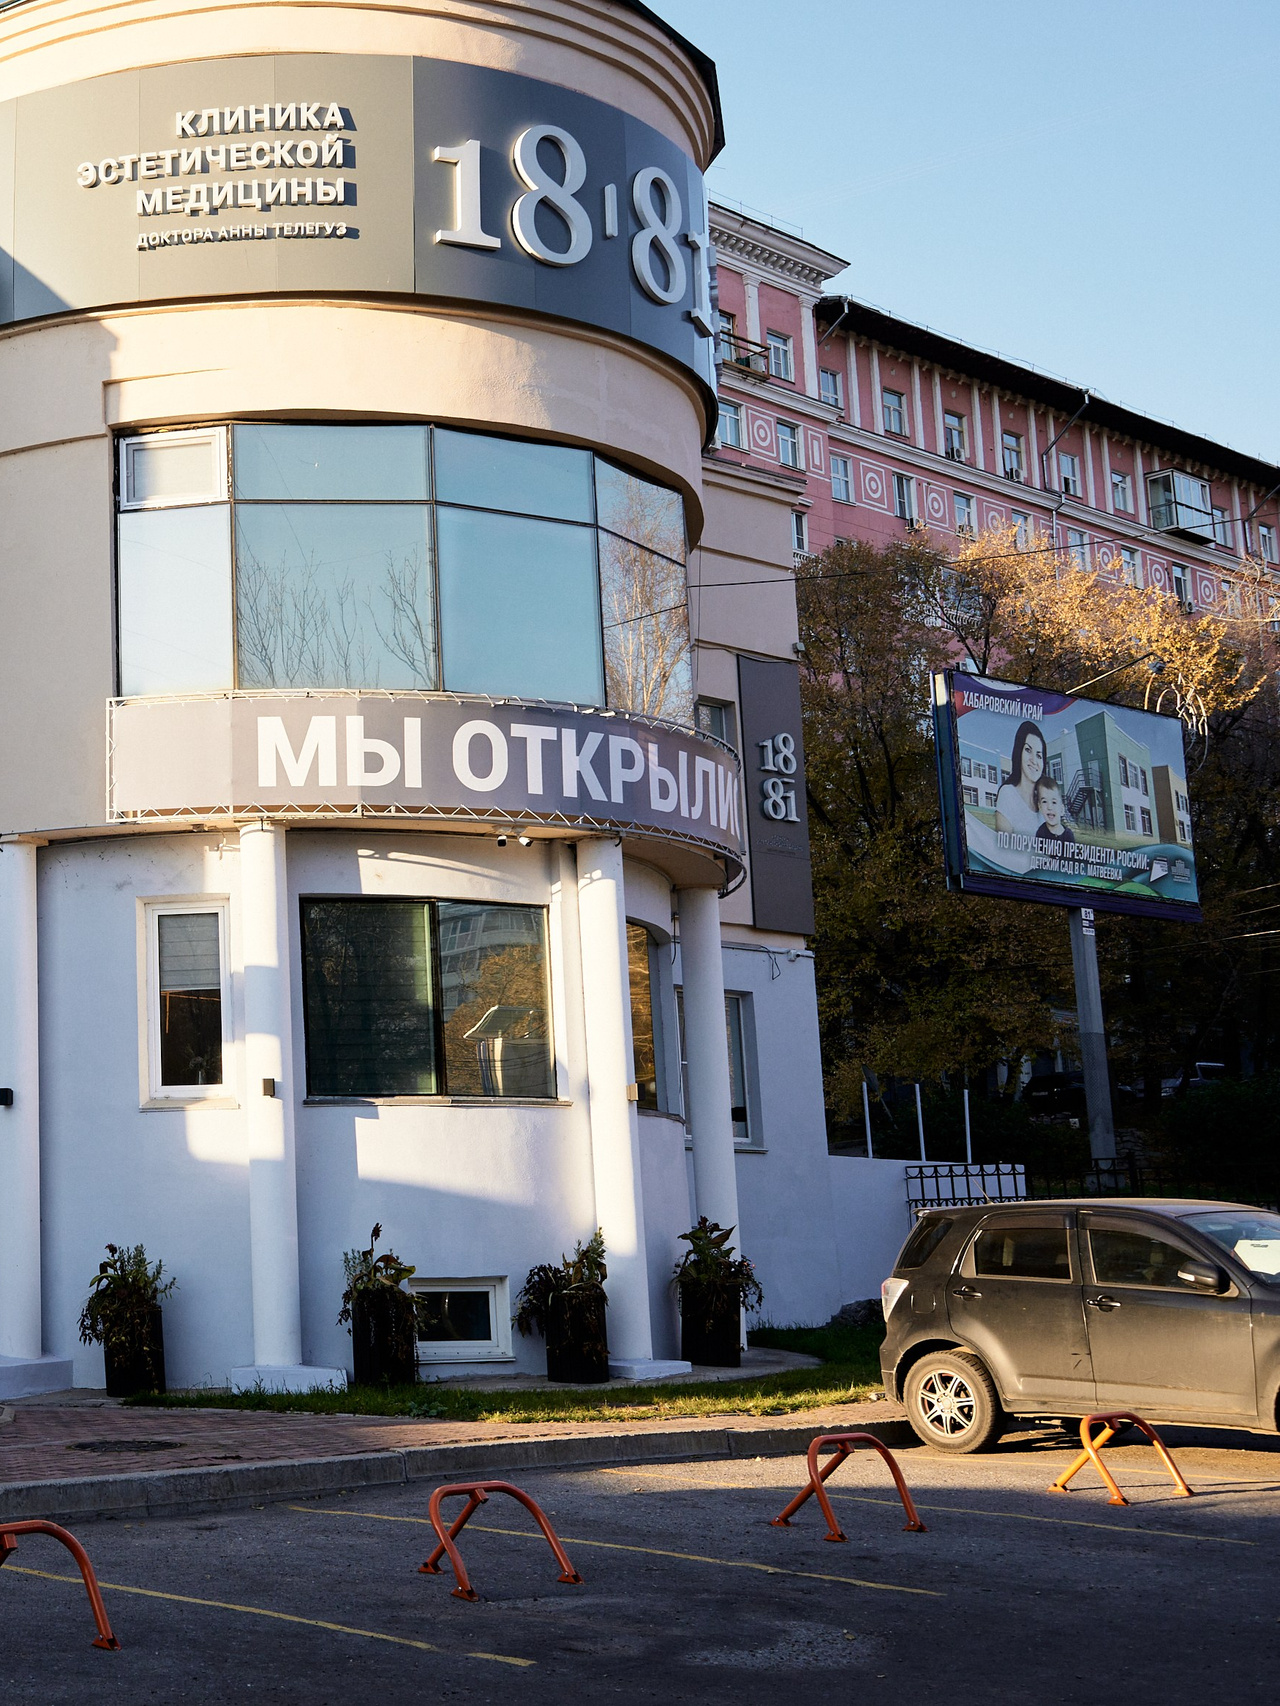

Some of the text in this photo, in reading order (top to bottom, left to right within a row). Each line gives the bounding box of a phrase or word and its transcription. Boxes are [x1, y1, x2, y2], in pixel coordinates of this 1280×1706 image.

[175, 102, 346, 138] КЛИНИКА
[76, 134, 345, 188] ЭСТЕТИЧЕСКОЙ
[136, 177, 346, 216] МЕДИЦИНЫ
[136, 221, 348, 250] ДОКТОРА АННЫ ТЕЛЕГУЗ
[962, 690, 1043, 721] ХАБАРОВСКИЙ КРАЙ
[257, 714, 422, 788] МЫ
[997, 831, 1009, 848] ПО
[1011, 834, 1062, 857] ПОРУЧЕНИЮ
[1063, 841, 1115, 864] ПРЕЗИДЕНТА
[1116, 850, 1150, 871] РОССИИ:
[1030, 855, 1060, 872] ДЕТСКИЙ
[1060, 860, 1074, 875] САД
[1074, 862, 1080, 874] В
[1087, 865, 1123, 881] МАТВЕЕВКА
